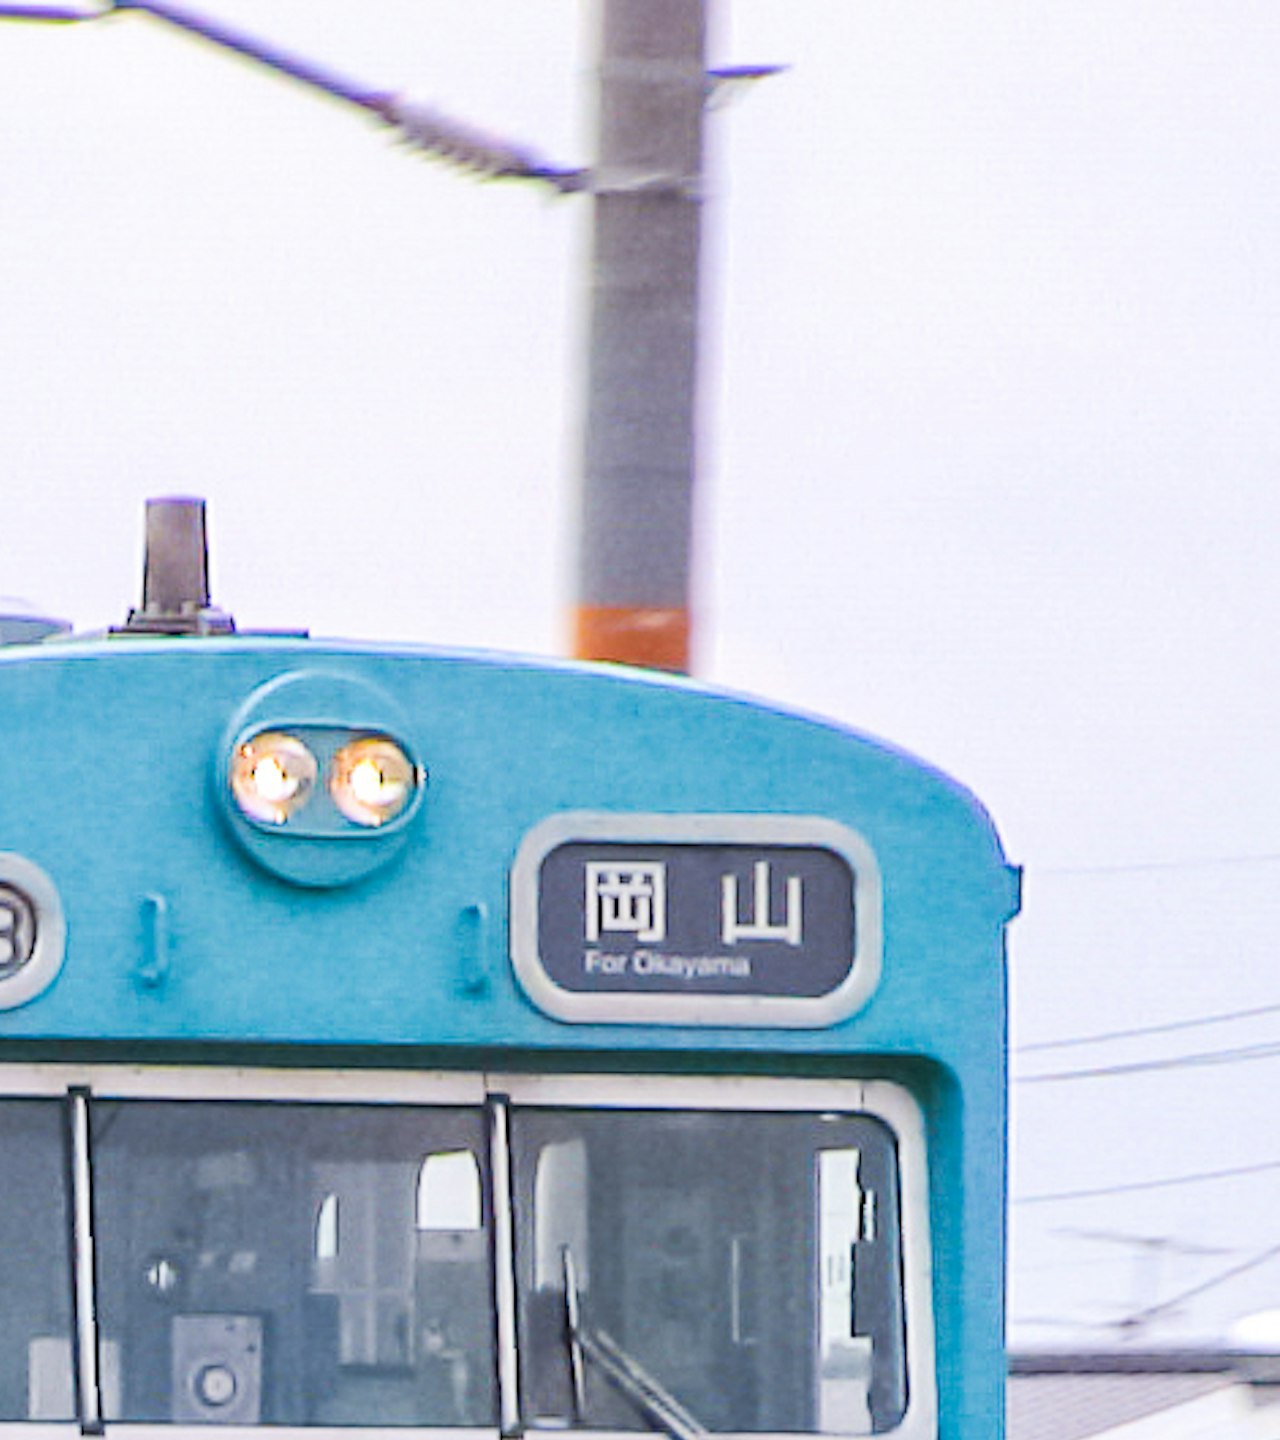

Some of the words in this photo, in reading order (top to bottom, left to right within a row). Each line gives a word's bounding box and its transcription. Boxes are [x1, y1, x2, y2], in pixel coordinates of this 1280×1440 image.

[584, 860, 803, 946] 岡山
[585, 951, 627, 974] For
[633, 951, 751, 979] Okayama
